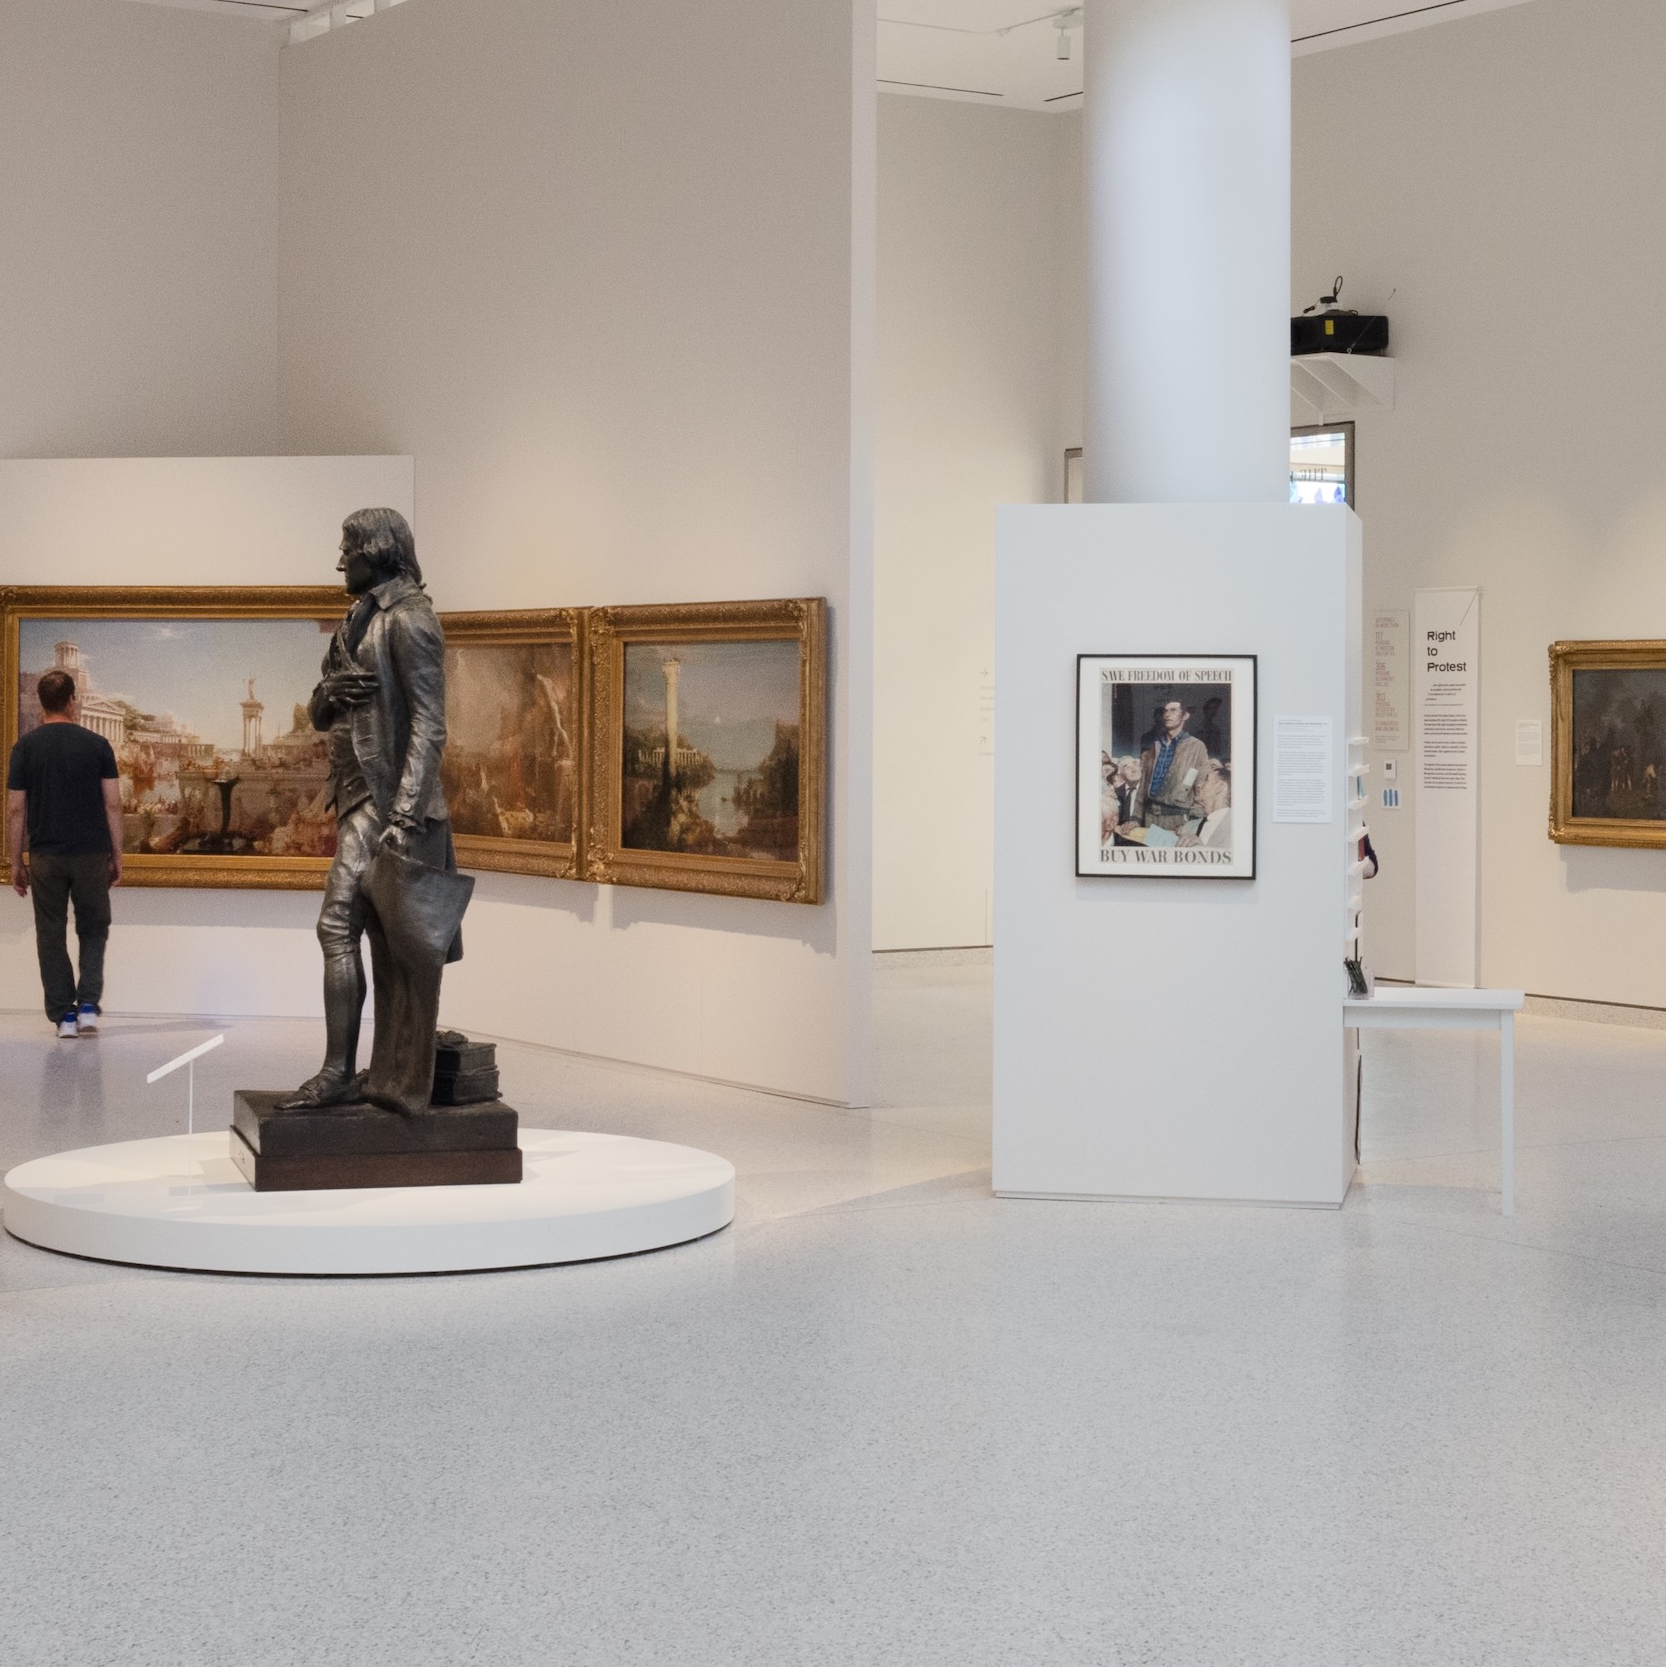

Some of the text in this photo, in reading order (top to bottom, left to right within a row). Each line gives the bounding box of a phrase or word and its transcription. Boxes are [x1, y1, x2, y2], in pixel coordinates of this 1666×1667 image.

[1427, 631, 1455, 642] Right
[1427, 646, 1438, 656] to
[1427, 661, 1466, 672] Protest
[1102, 670, 1231, 681] SAVE FREEDOM OF SPEECH
[1101, 850, 1231, 864] BUY WAR BONDS
